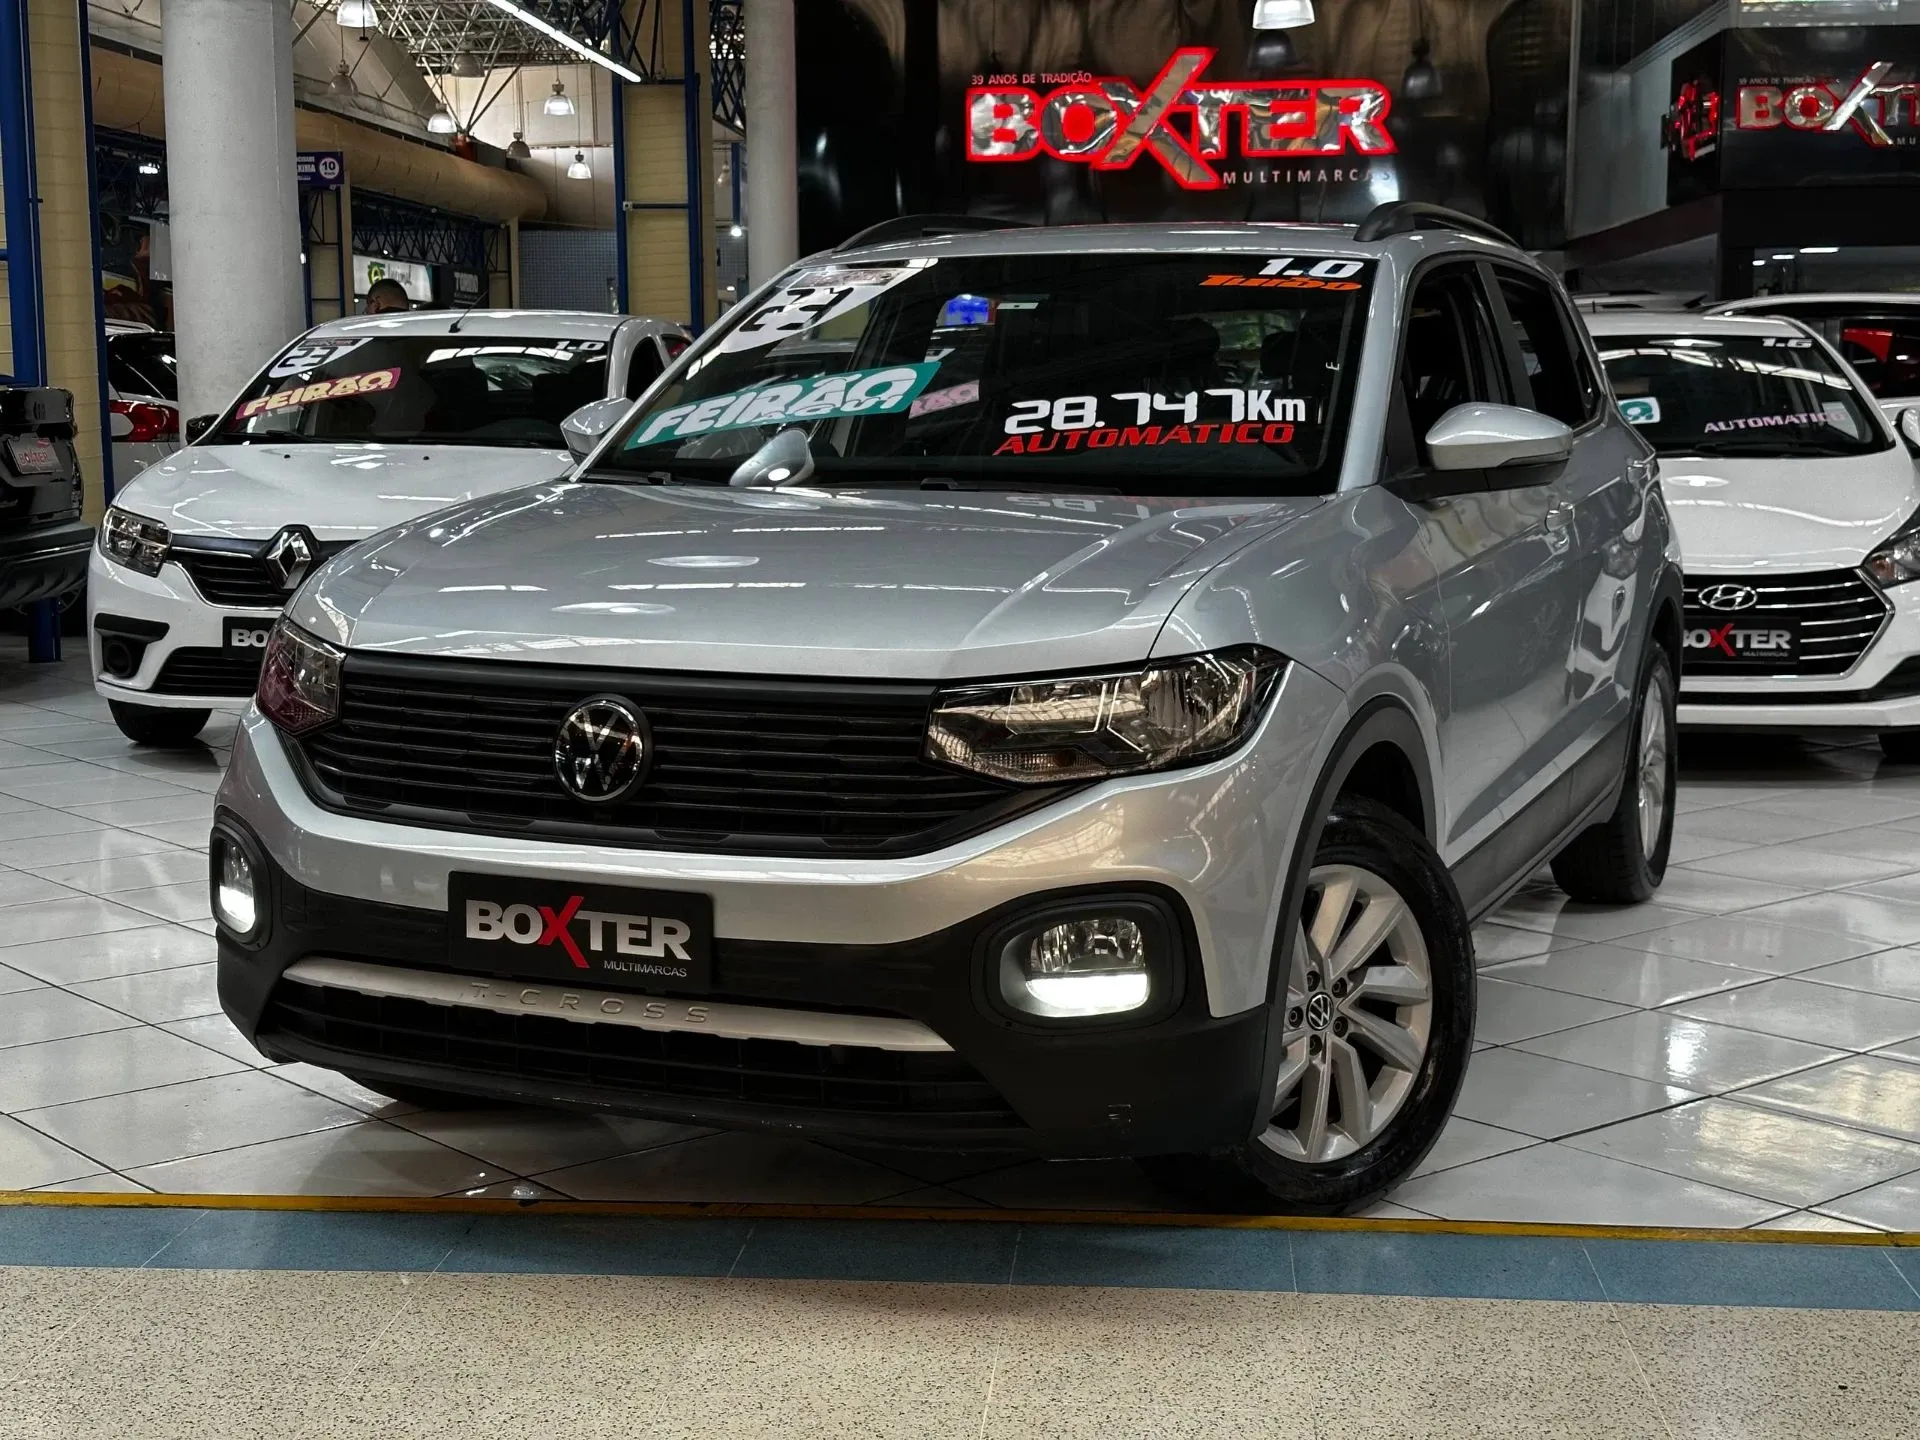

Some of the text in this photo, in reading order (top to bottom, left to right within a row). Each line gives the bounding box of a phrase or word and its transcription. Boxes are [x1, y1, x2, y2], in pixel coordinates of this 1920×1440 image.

[971, 71, 1092, 85] 39 ANOS DE TRADIÇÃO
[1735, 60, 1920, 147] BOXT
[966, 47, 1398, 190] BOXTER
[322, 161, 336, 171] 10
[1222, 168, 1390, 184] MULTIMARCAS
[1259, 257, 1365, 278] 1.0
[554, 340, 605, 351] 1.0
[277, 346, 339, 368] 23
[465, 895, 692, 969] BOXTER
[603, 959, 688, 978] MULTIMARCAS
[471, 981, 710, 1024] T-CROSS
